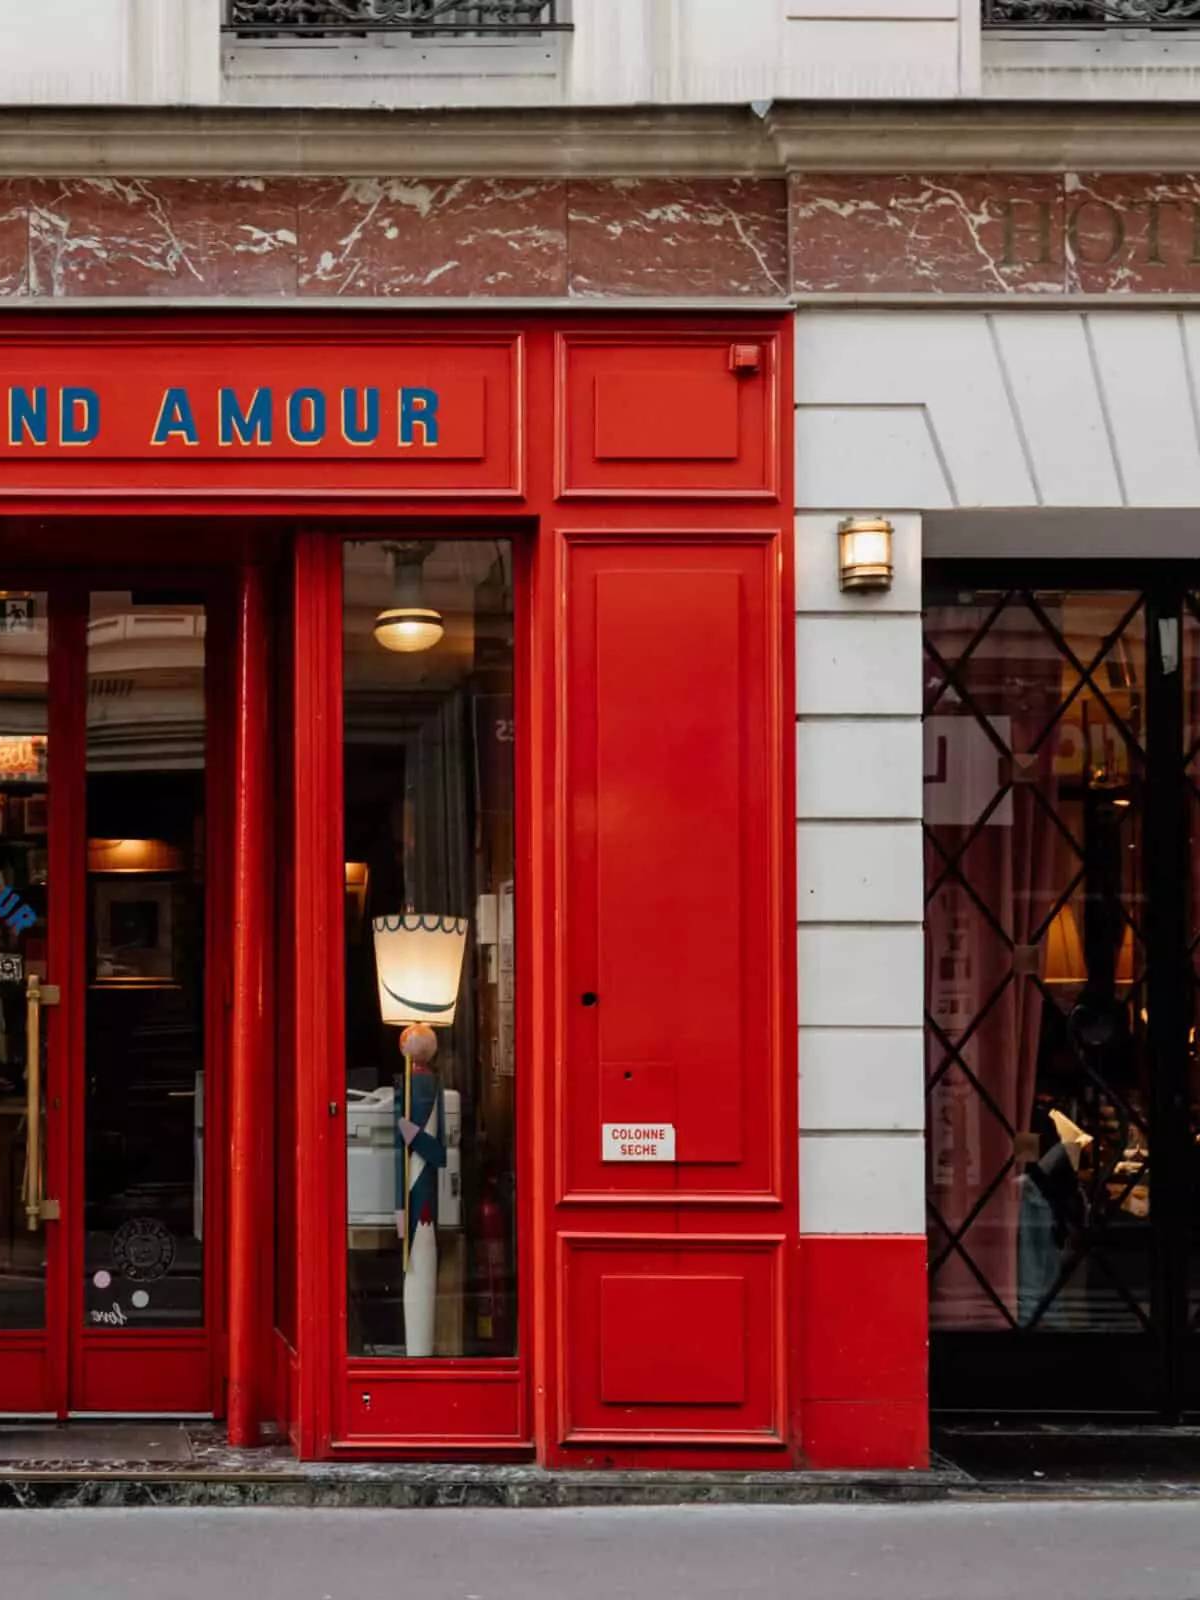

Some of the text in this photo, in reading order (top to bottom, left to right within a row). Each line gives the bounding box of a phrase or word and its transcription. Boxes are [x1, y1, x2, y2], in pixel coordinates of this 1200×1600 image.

[150, 387, 441, 447] AMOUR
[611, 1128, 666, 1140] COLONNE
[620, 1143, 657, 1156] SECHE
